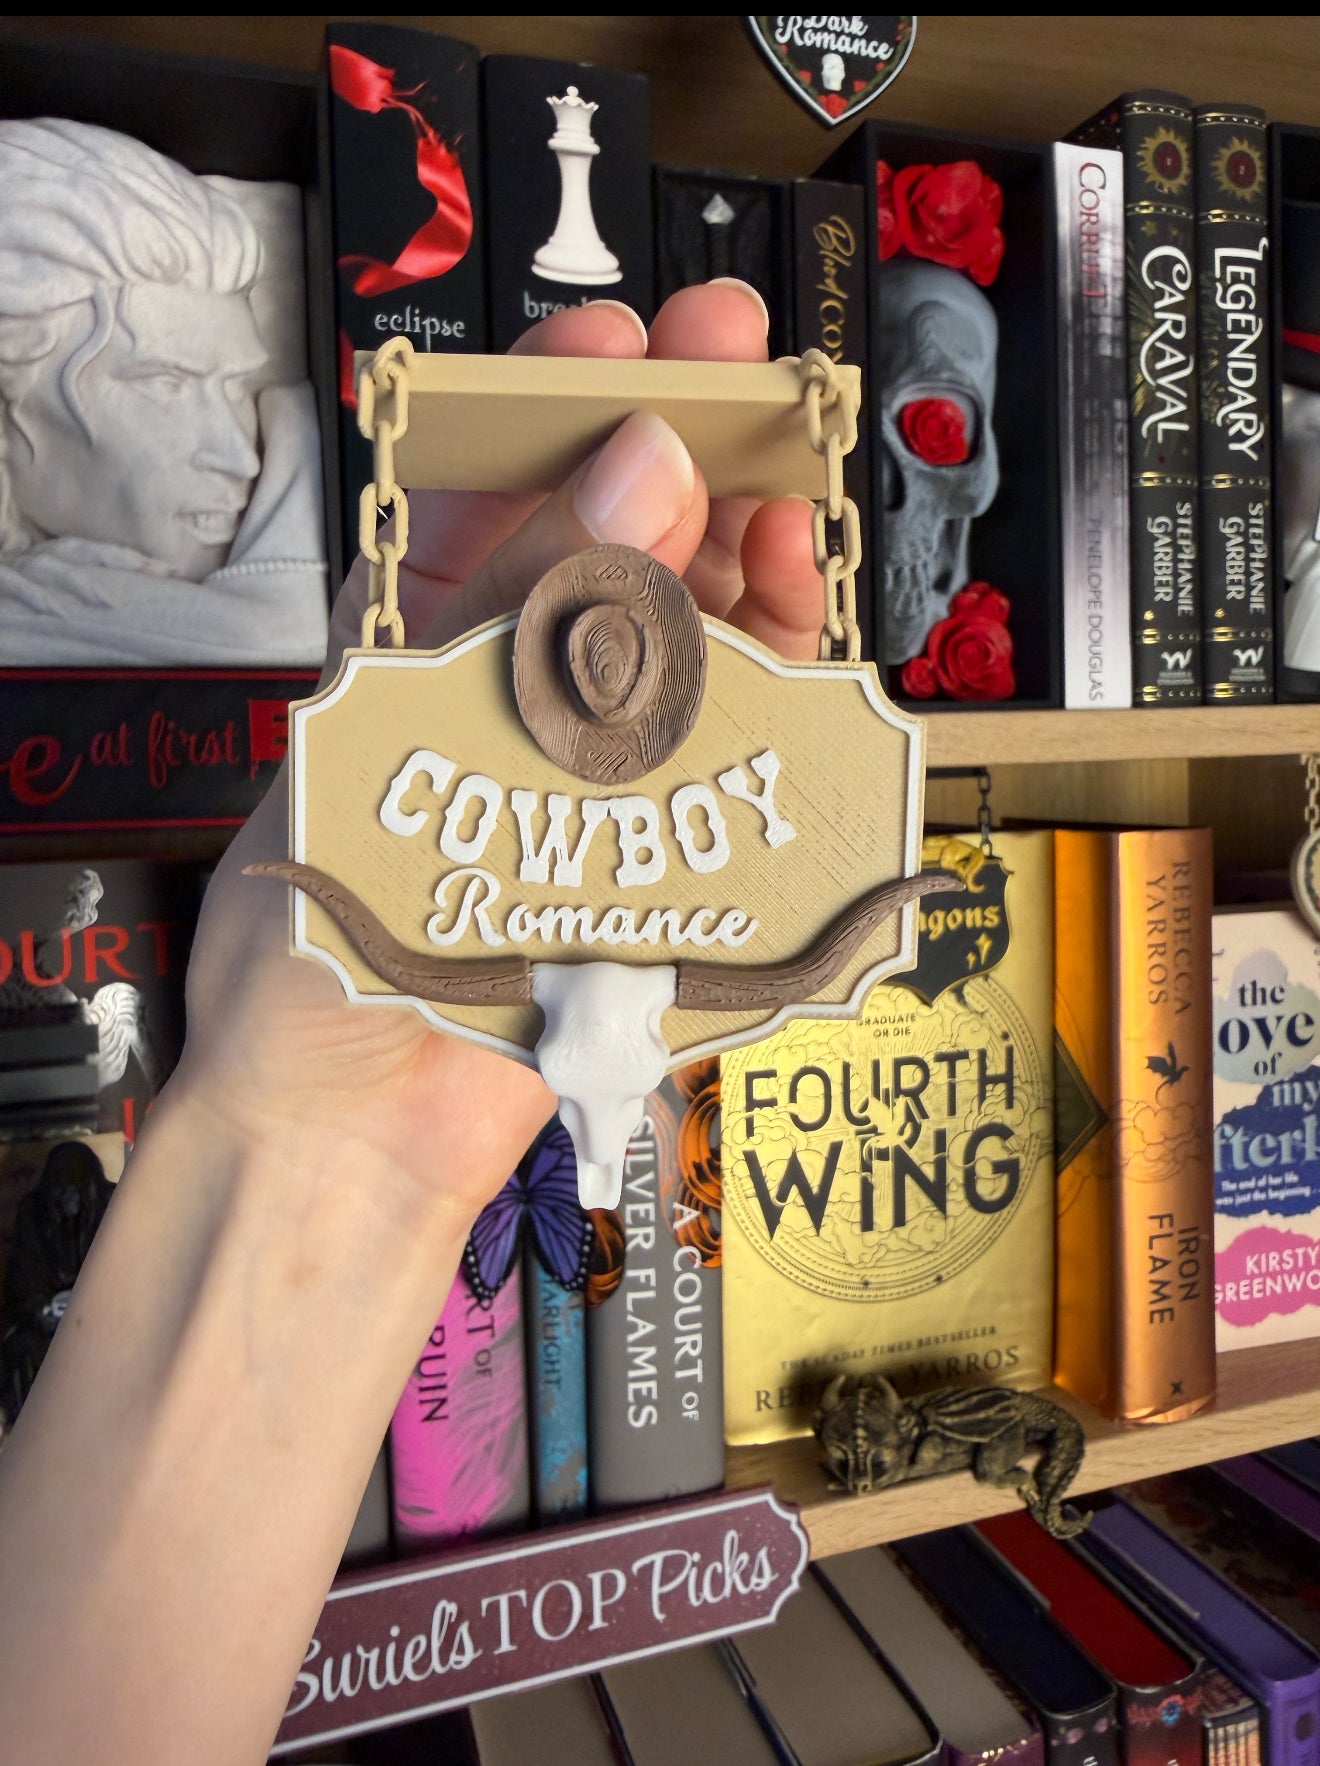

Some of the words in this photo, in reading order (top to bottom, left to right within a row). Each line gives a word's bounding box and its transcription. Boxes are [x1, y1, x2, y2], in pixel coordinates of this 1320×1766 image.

[775, 15, 893, 60] Romance
[374, 303, 466, 352] eclipse
[1140, 245, 1194, 443] CARAVAL
[1214, 237, 1269, 461] LEGENDARY
[1087, 516, 1104, 610] PENELOPE
[1146, 516, 1174, 602] GARBER
[1175, 501, 1196, 617] STEPHANIE
[1219, 516, 1246, 600] GARBER
[1248, 502, 1268, 616] STEPHANIE
[1087, 615, 1104, 702] DOUGLAS
[89, 722, 136, 767] at
[147, 710, 240, 789] first
[379, 749, 798, 888] COWBOY
[427, 867, 759, 947] Romance
[1146, 874, 1169, 1006] YARROS
[1172, 859, 1193, 1016] REBECCA
[873, 1028, 889, 1038] OR
[893, 1026, 912, 1038] DIE
[1239, 979, 1285, 1008] the
[743, 1041, 1016, 1137] FOURTH
[1253, 1051, 1284, 1077] of
[1272, 1079, 1320, 1113] my
[624, 1115, 656, 1252] SILVER
[672, 1201, 701, 1230] A
[743, 1122, 1021, 1241] WING
[1221, 1180, 1238, 1192] The
[1147, 1213, 1175, 1324] FLAME
[1177, 1226, 1200, 1302] IRON
[1245, 1244, 1320, 1276] KIRSTY
[626, 1268, 659, 1429] FLAMES
[672, 1244, 704, 1383] COURT
[474, 1349, 493, 1377] OF
[680, 1391, 700, 1422] OF
[481, 1567, 628, 1656] TOP
[632, 1529, 780, 1622] Picks
